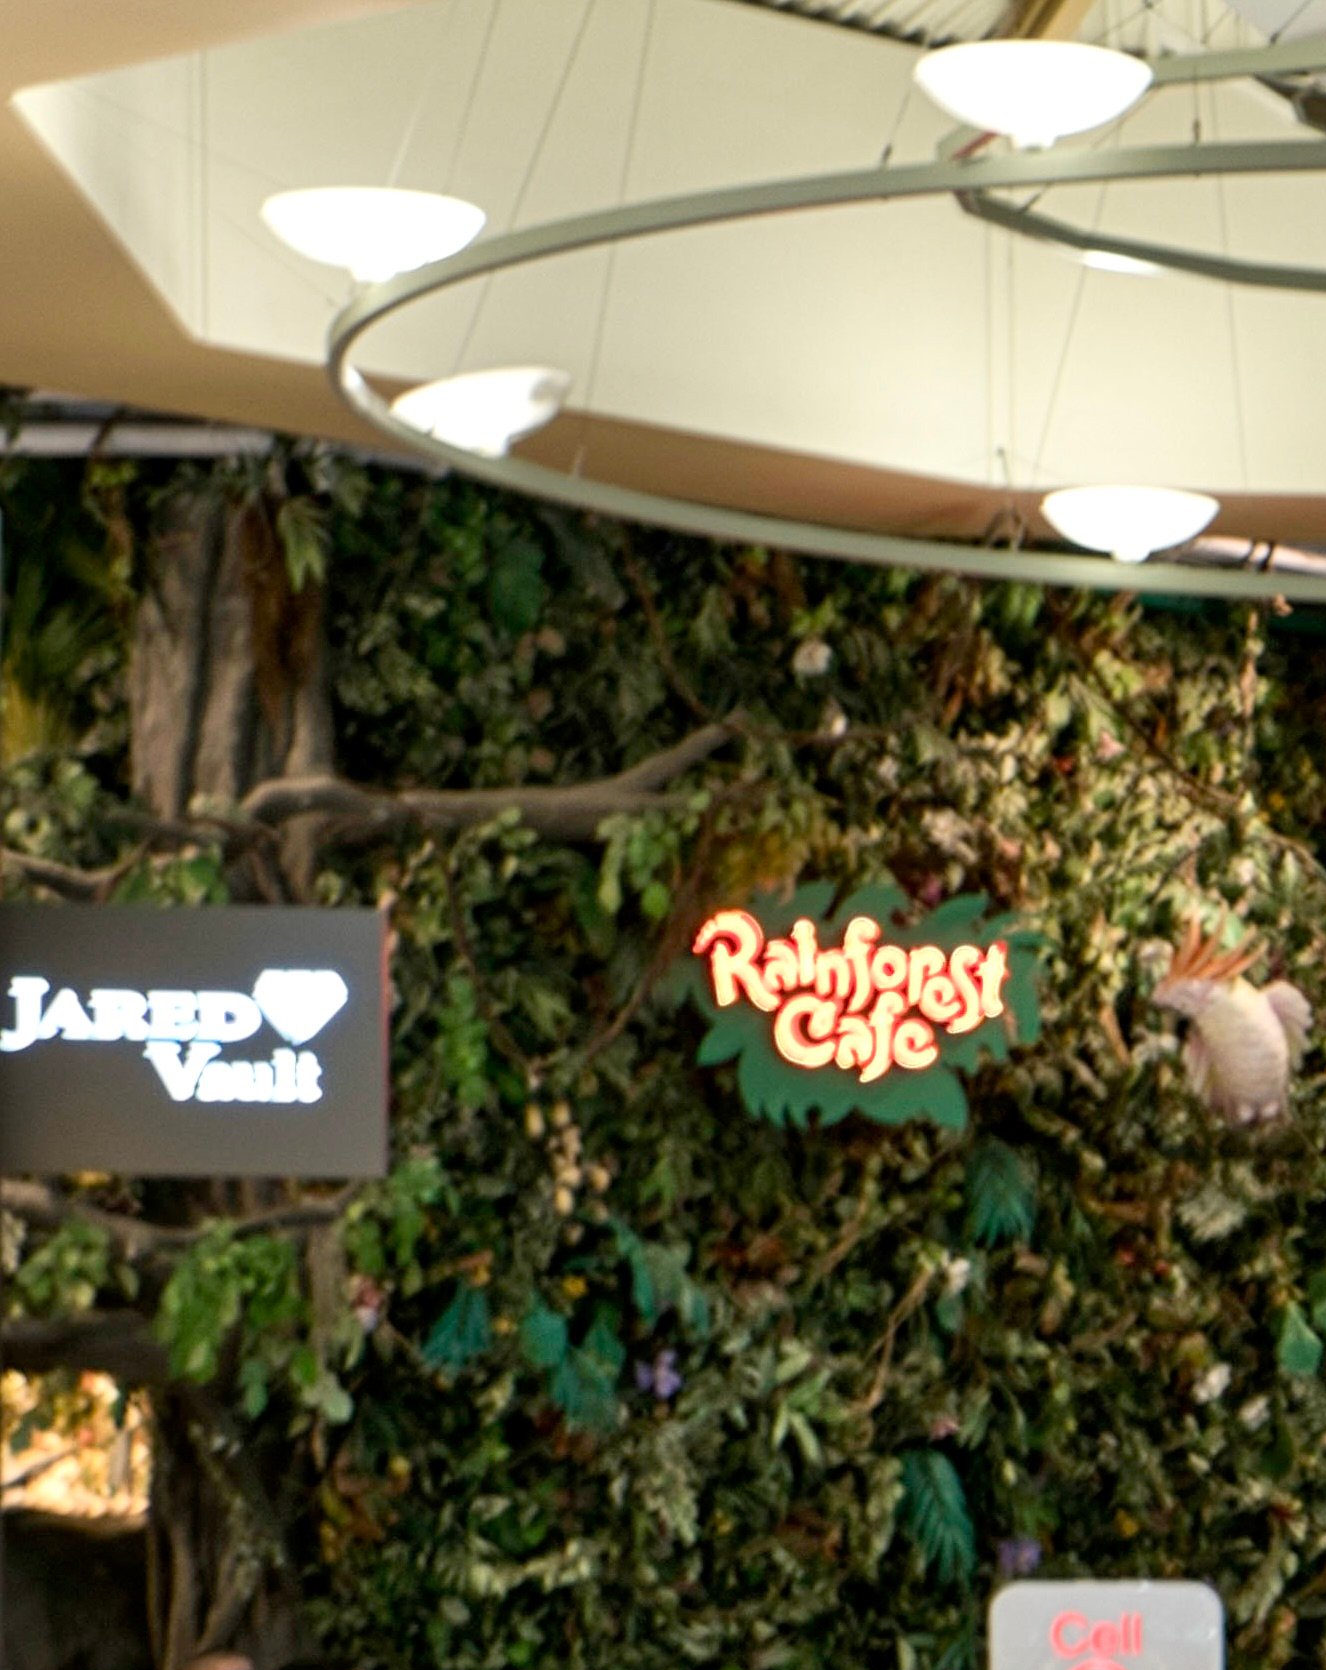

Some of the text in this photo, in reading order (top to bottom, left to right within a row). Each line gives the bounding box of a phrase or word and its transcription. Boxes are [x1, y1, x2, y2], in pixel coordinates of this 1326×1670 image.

[693, 909, 1010, 1034] Rainforest
[143, 1040, 324, 1104] Vault
[1049, 1610, 1143, 1660] Cell
